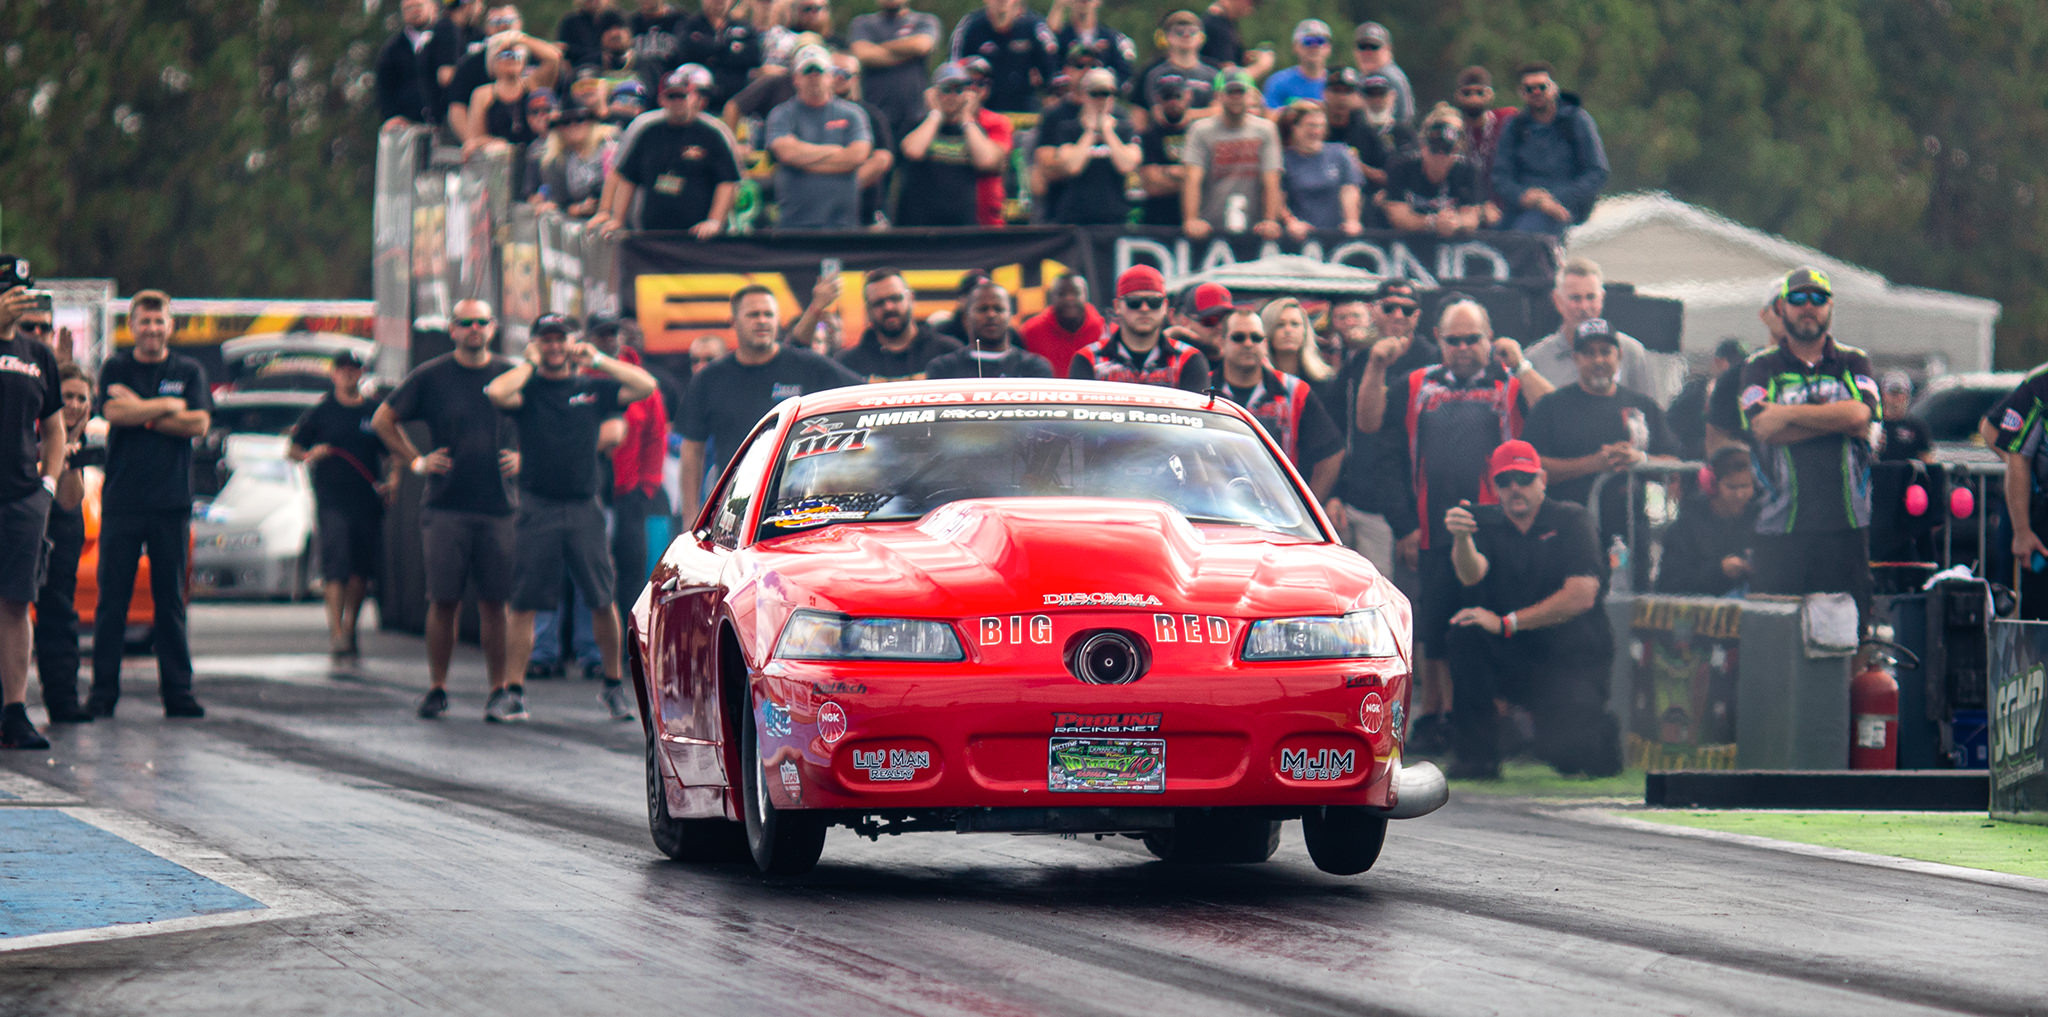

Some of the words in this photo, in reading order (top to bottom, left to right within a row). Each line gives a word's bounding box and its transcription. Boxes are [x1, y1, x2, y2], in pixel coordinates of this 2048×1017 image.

[1115, 238, 1509, 290] DIAMOND
[857, 392, 965, 407] #NMCA
[972, 390, 1078, 402] RACING
[856, 409, 936, 429] NMRA
[963, 408, 1068, 420] Keystone
[1073, 408, 1125, 423] Drag
[1128, 409, 1204, 428] Racing
[1043, 592, 1163, 606] DISOMMA
[980, 614, 1053, 646] BIG
[1153, 613, 1231, 644] RED
[1365, 703, 1381, 713] NGK
[1994, 668, 2044, 763] SGMP
[821, 712, 840, 722] NGK
[1054, 725, 1158, 733] RACING.NET
[891, 749, 930, 769] MAN
[1281, 748, 1355, 772] MJM
[869, 766, 916, 781] REALTY
[1293, 767, 1342, 780] CORP
